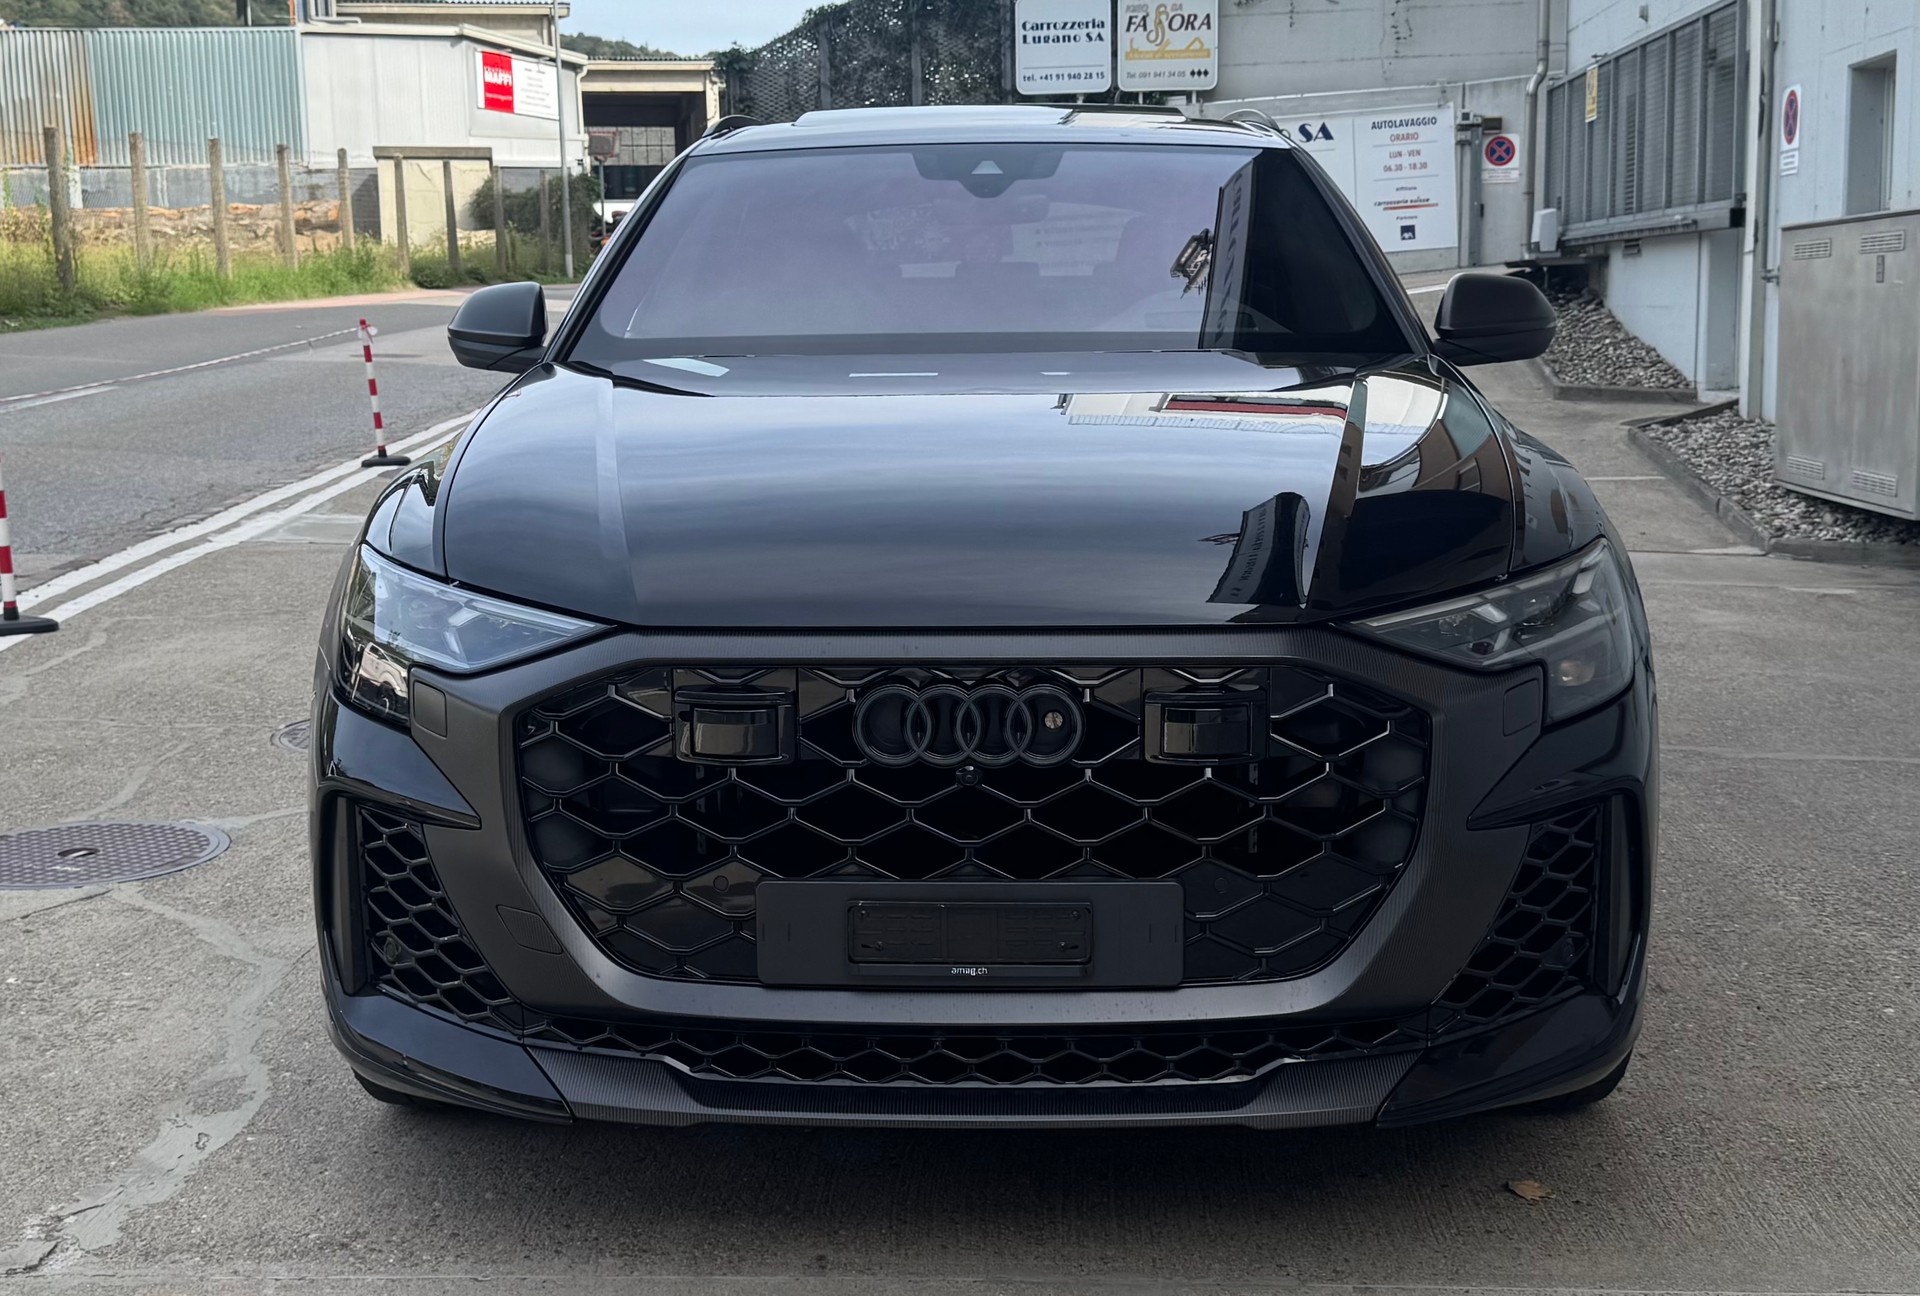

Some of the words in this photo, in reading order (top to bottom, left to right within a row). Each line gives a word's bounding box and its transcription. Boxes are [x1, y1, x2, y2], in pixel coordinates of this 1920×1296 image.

[1021, 18, 1105, 32] Carrozzeria
[1022, 33, 1081, 45] Lugano
[1085, 31, 1104, 43] SA
[1055, 73, 1065, 81] 91
[1096, 71, 1105, 80] 15
[1371, 116, 1437, 130] AUTOLAVAGGIO
[1298, 121, 1334, 143] SA
[1389, 132, 1419, 143] ORARIO
[1389, 151, 1402, 159] LUN
[1407, 149, 1421, 157] VEN
